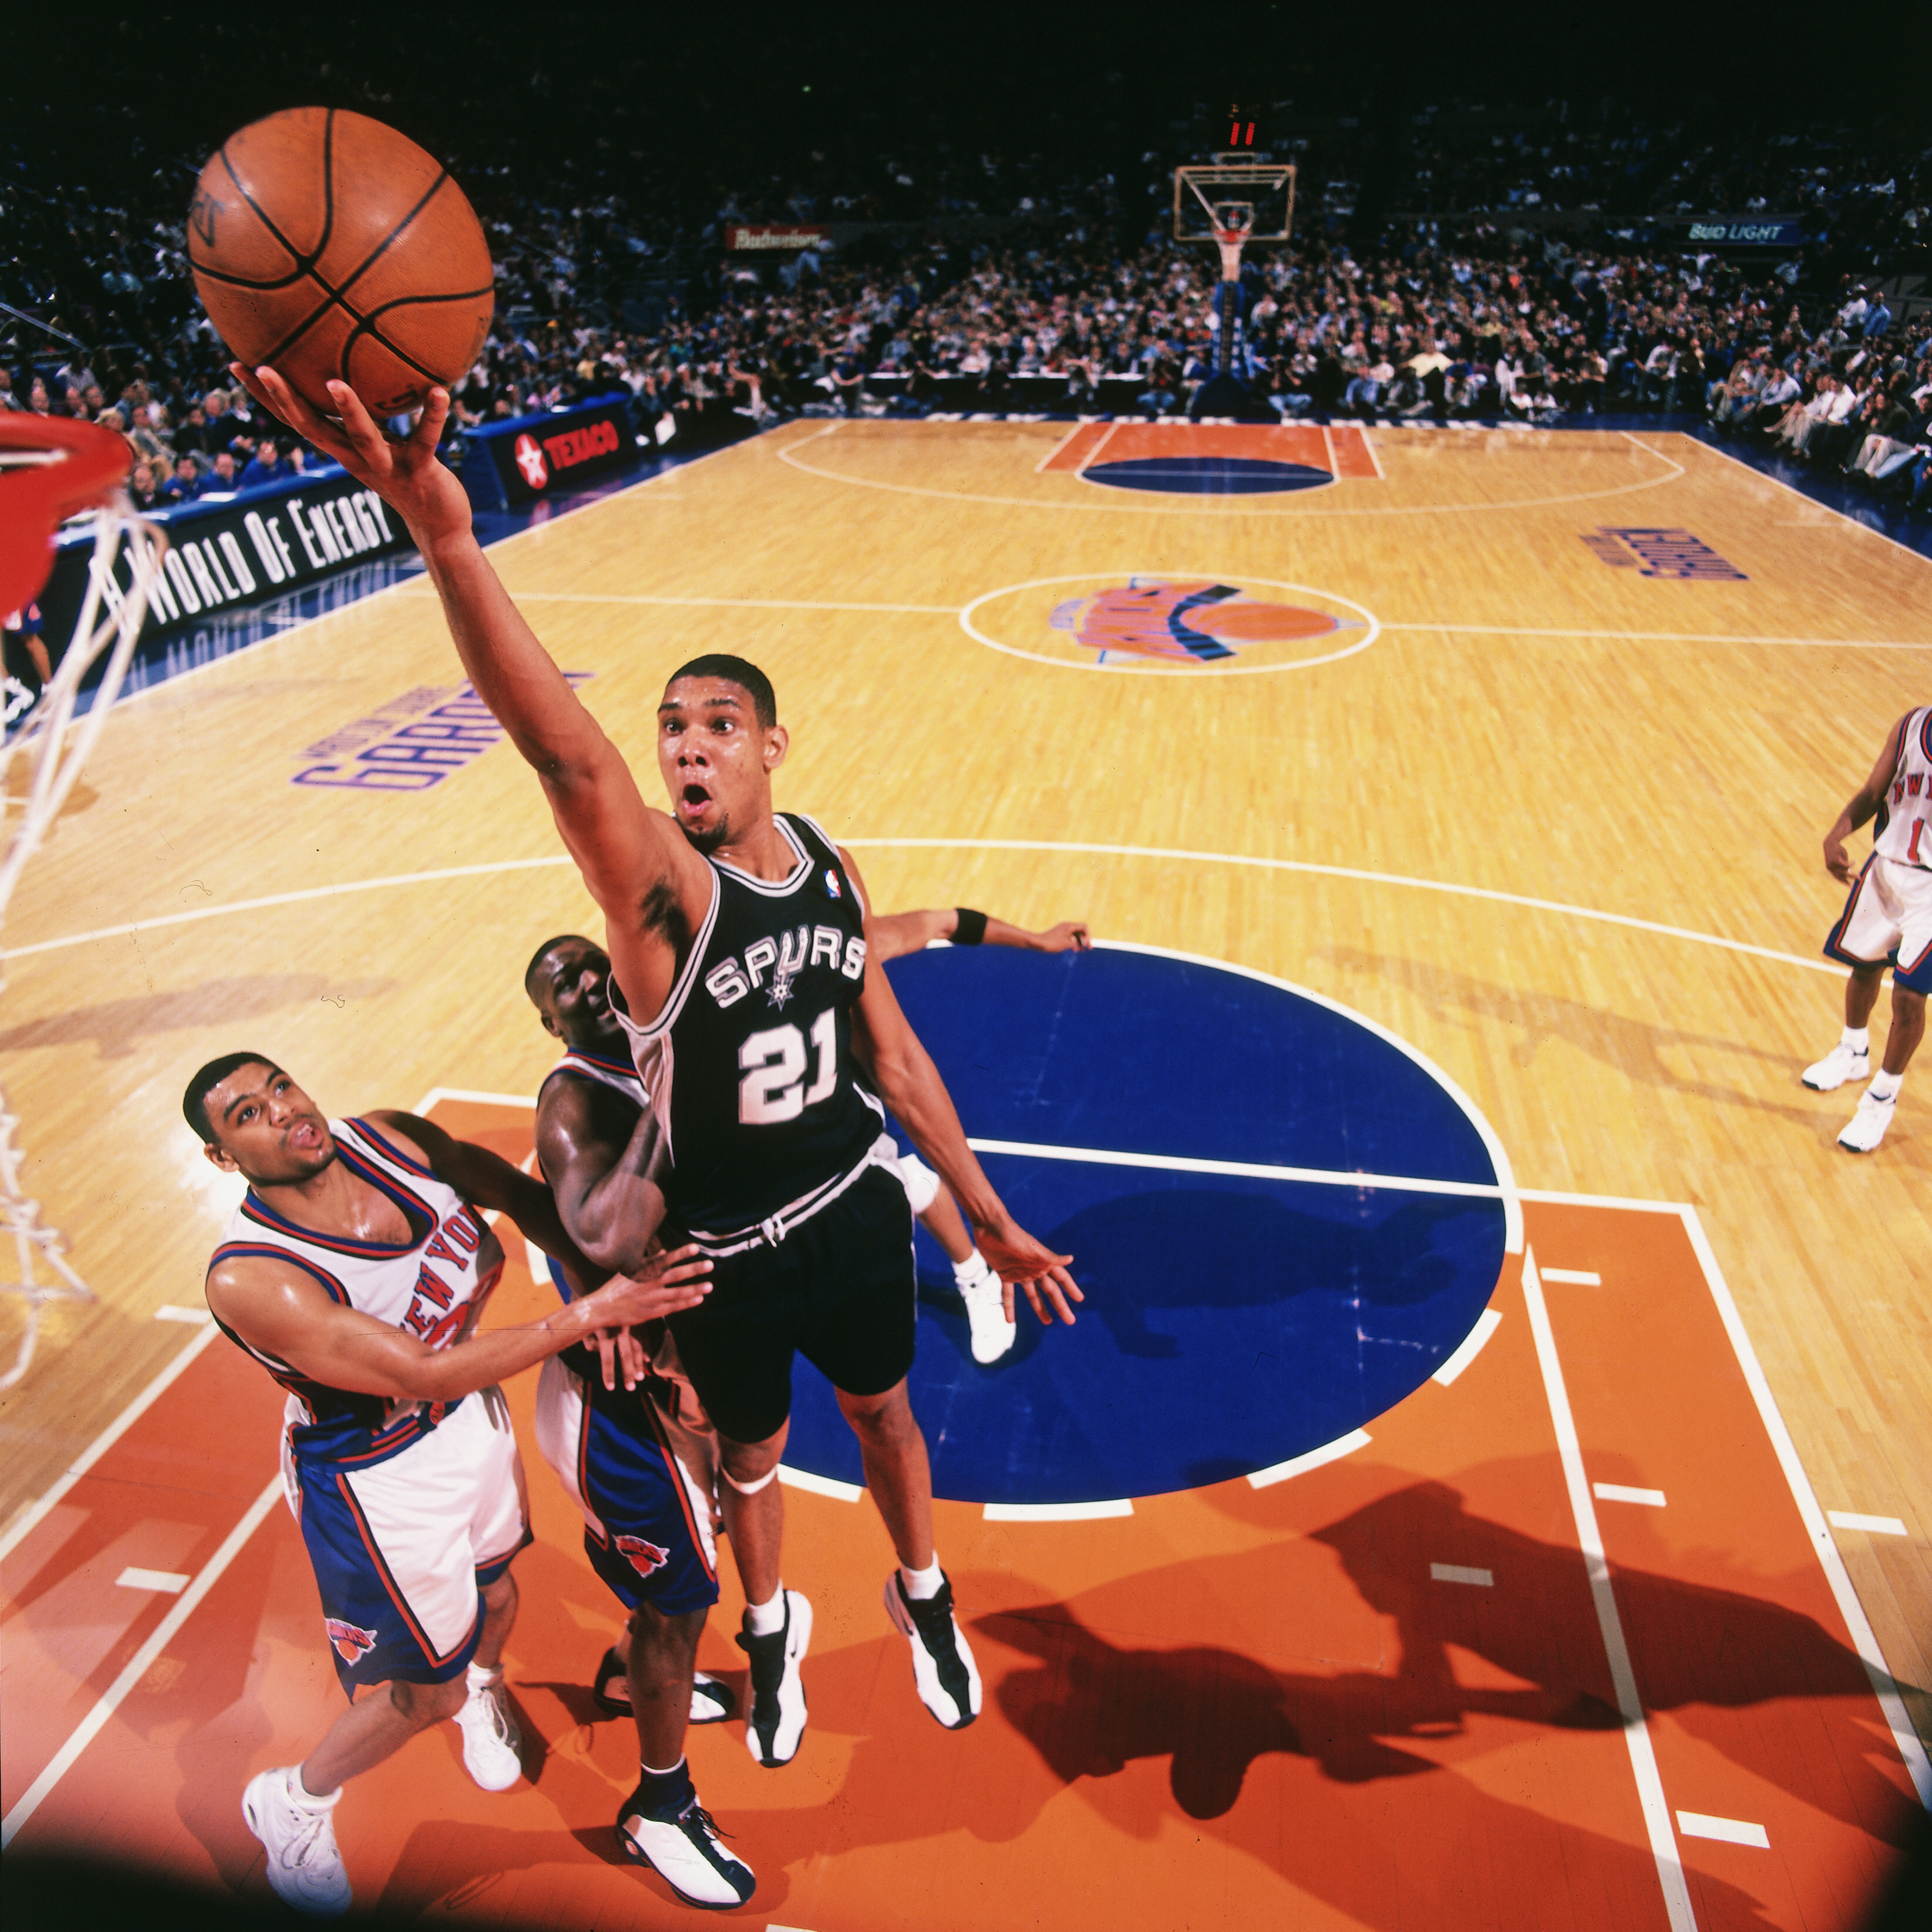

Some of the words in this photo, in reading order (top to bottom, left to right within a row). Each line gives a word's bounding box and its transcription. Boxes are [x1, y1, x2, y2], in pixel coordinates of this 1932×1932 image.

[1728, 223, 1783, 240] LIGHT
[542, 420, 619, 471] TEXACO
[122, 531, 256, 624] WORLD
[286, 489, 394, 569] ENERGY
[705, 924, 867, 1009] SPURS
[738, 1006, 838, 1125] 21
[400, 1261, 455, 1336] EW
